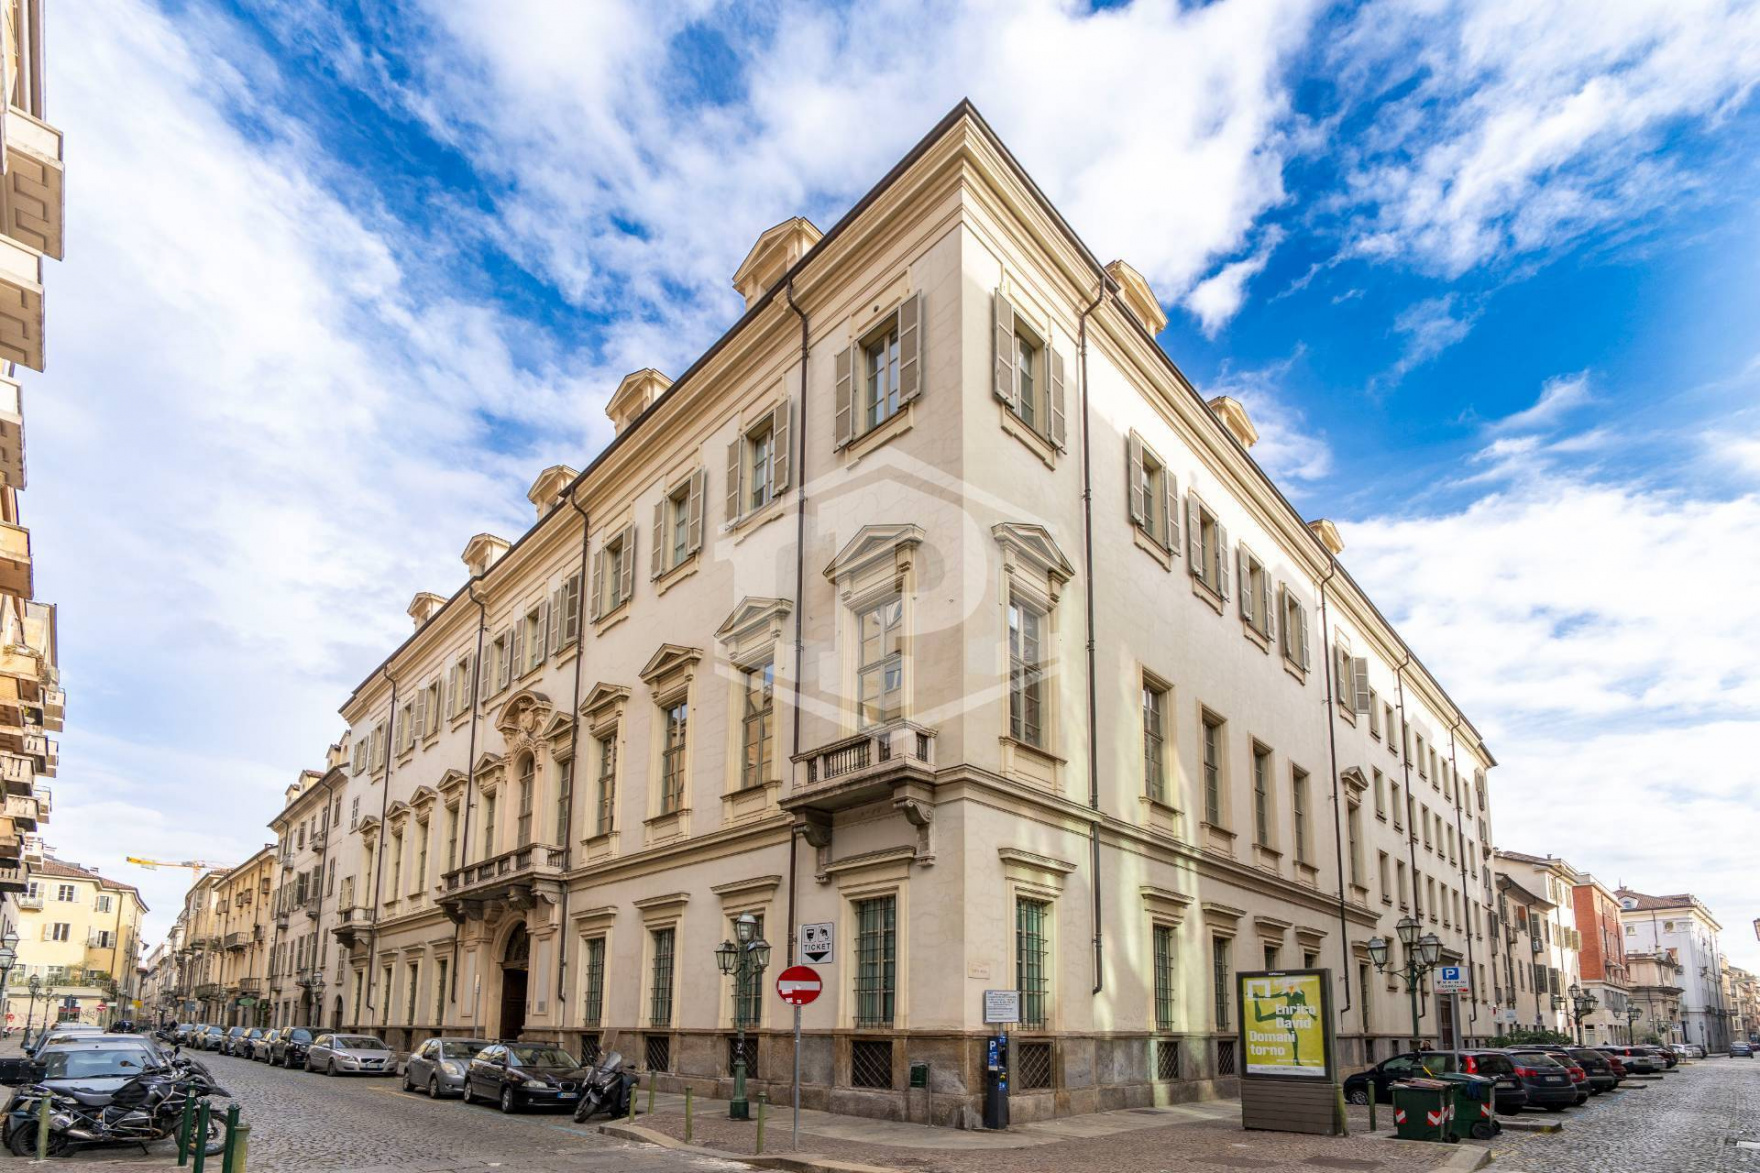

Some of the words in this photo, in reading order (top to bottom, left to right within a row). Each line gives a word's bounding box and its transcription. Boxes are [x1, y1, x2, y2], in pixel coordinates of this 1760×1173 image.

[804, 943, 831, 951] TICKET
[1446, 969, 1455, 979] P
[1276, 1003, 1316, 1015] Enrico
[1276, 1016, 1312, 1028] David
[1250, 1031, 1295, 1042] Domani
[989, 1040, 996, 1050] P
[1250, 1045, 1285, 1055] torno
